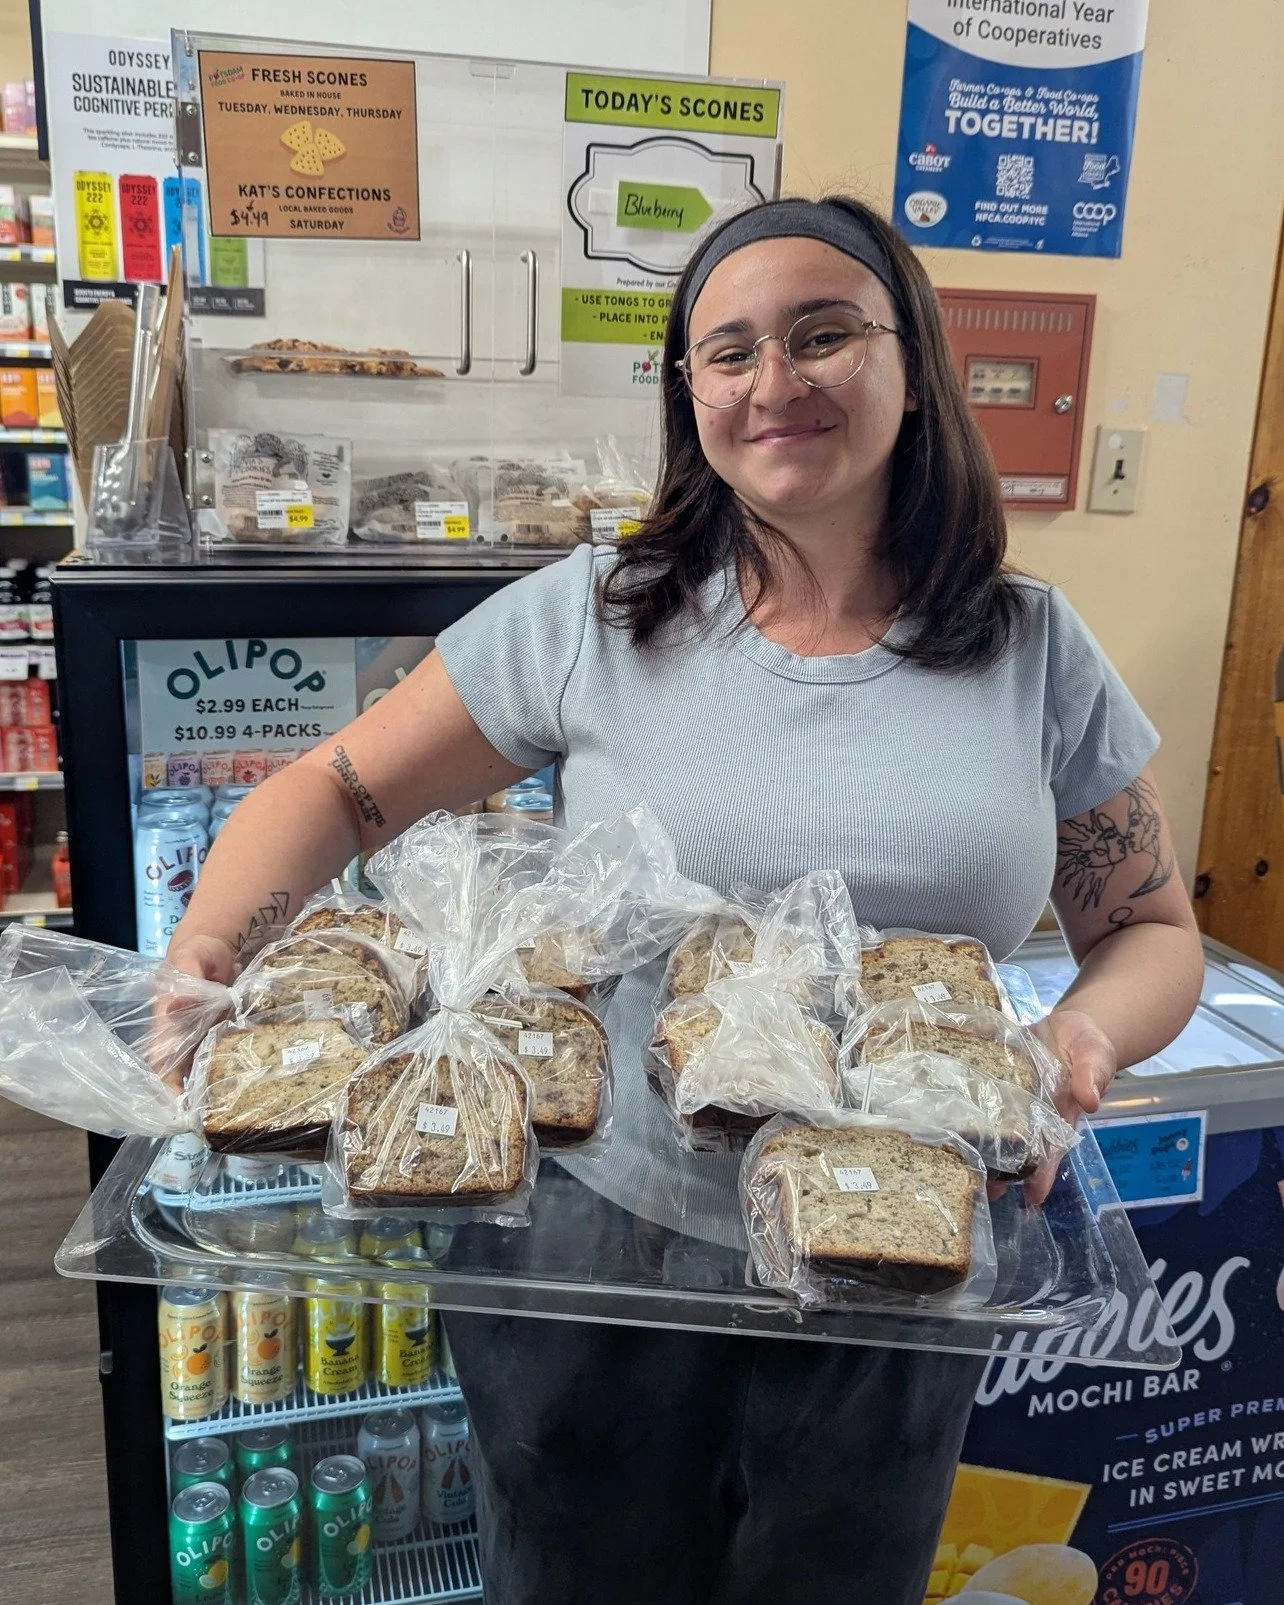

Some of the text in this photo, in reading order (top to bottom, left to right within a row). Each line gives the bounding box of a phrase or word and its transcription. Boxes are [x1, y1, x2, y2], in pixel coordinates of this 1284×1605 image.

[1073, 1, 1114, 24] Year
[953, 18, 1102, 49] of Cooperatives
[109, 50, 170, 70] ODYSSEY
[72, 73, 178, 100] SUSTAINABLE
[251, 68, 368, 87] FRESH SCONES
[280, 89, 342, 100] BAKED IN HOUSE
[949, 78, 985, 93] Farmer
[1025, 87, 1034, 97] &
[1036, 87, 1063, 100] Food
[73, 96, 141, 116] COGNITIVE
[218, 101, 403, 120] TUESDAY, WEDNESDAY, THURSDAY
[581, 88, 764, 122] TODAY'S SCONES
[949, 92, 1099, 121] Build a Better World,
[945, 108, 1100, 145] TOGETHER!
[76, 180, 112, 193] ODYSSEY
[121, 183, 156, 195] ODYSSEY
[238, 184, 392, 202] KAT'S CONFECTIONS
[86, 193, 103, 203] 222
[131, 195, 148, 206] 222
[279, 205, 354, 215] LOCAL BAKED GOODS
[624, 193, 684, 228] Blueberry
[975, 201, 1048, 215] FIND OUT MORE
[230, 208, 270, 228] $4.49
[290, 219, 345, 231] SATURDAY
[616, 277, 645, 288] Prepared
[645, 279, 654, 289] by
[581, 295, 602, 306] USE
[604, 296, 639, 307] TONGS
[643, 298, 655, 308] TO
[599, 312, 631, 324] PLACE
[634, 314, 658, 325] INTO
[632, 375, 659, 385] FOOD
[166, 639, 326, 700] OLIPOP
[196, 697, 299, 715] $2.99 EACH
[174, 723, 322, 742] $10.99 4-PACKS
[424, 1106, 448, 1115] 42167
[320, 1354, 359, 1366] Banana
[323, 1365, 358, 1376] Cream
[170, 1379, 213, 1391] Orange
[1027, 1368, 1200, 1418] MOCHI BAR
[169, 1389, 214, 1403] Squeeze
[1144, 1407, 1222, 1444] SUPER
[1103, 1457, 1145, 1483] ICE
[1153, 1440, 1242, 1473] CREAM
[1129, 1485, 1155, 1508] IN
[1163, 1467, 1246, 1501] SWEET
[1123, 1559, 1170, 1597] 90
